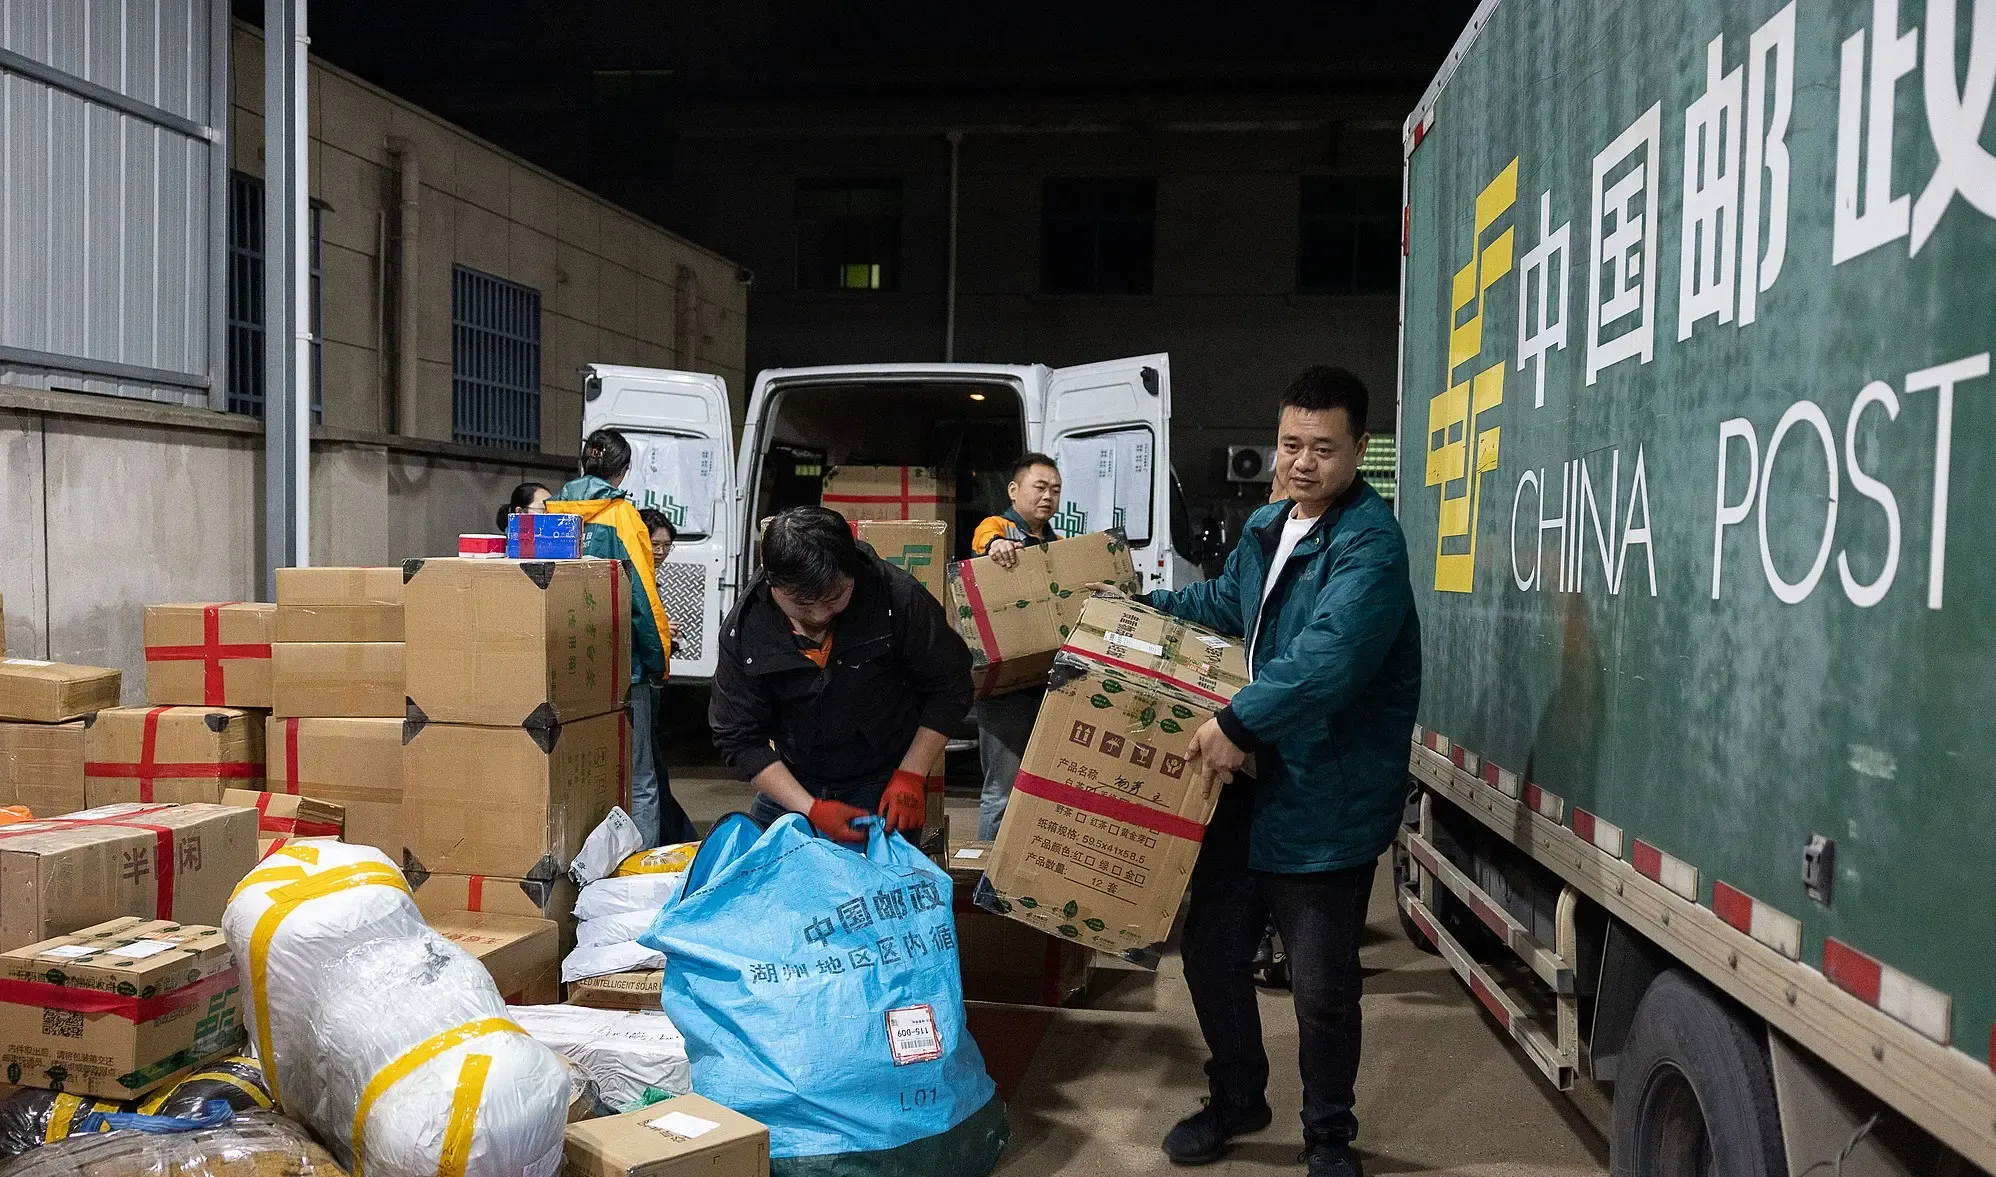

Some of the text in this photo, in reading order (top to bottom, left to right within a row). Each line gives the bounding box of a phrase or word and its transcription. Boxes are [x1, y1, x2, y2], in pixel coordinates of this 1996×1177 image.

[1516, 0, 1996, 408] 中国邮政
[1511, 352, 1991, 610] CHINA POST
[1056, 757, 1099, 781] 产品名称
[1036, 817, 1081, 841] 纸箱规格:
[1055, 804, 1147, 845] 野茶 红茶 黄金芽
[123, 836, 202, 885] 半闲
[1024, 852, 1119, 894] 产品数量: 12 套
[1030, 835, 1074, 858] 产品颜色:
[1073, 850, 1084, 862] 红
[1125, 869, 1136, 881] 金
[803, 880, 946, 947] 中国邮政
[593, 979, 635, 990] INTELLIGENT
[635, 982, 658, 991] SOLAR
